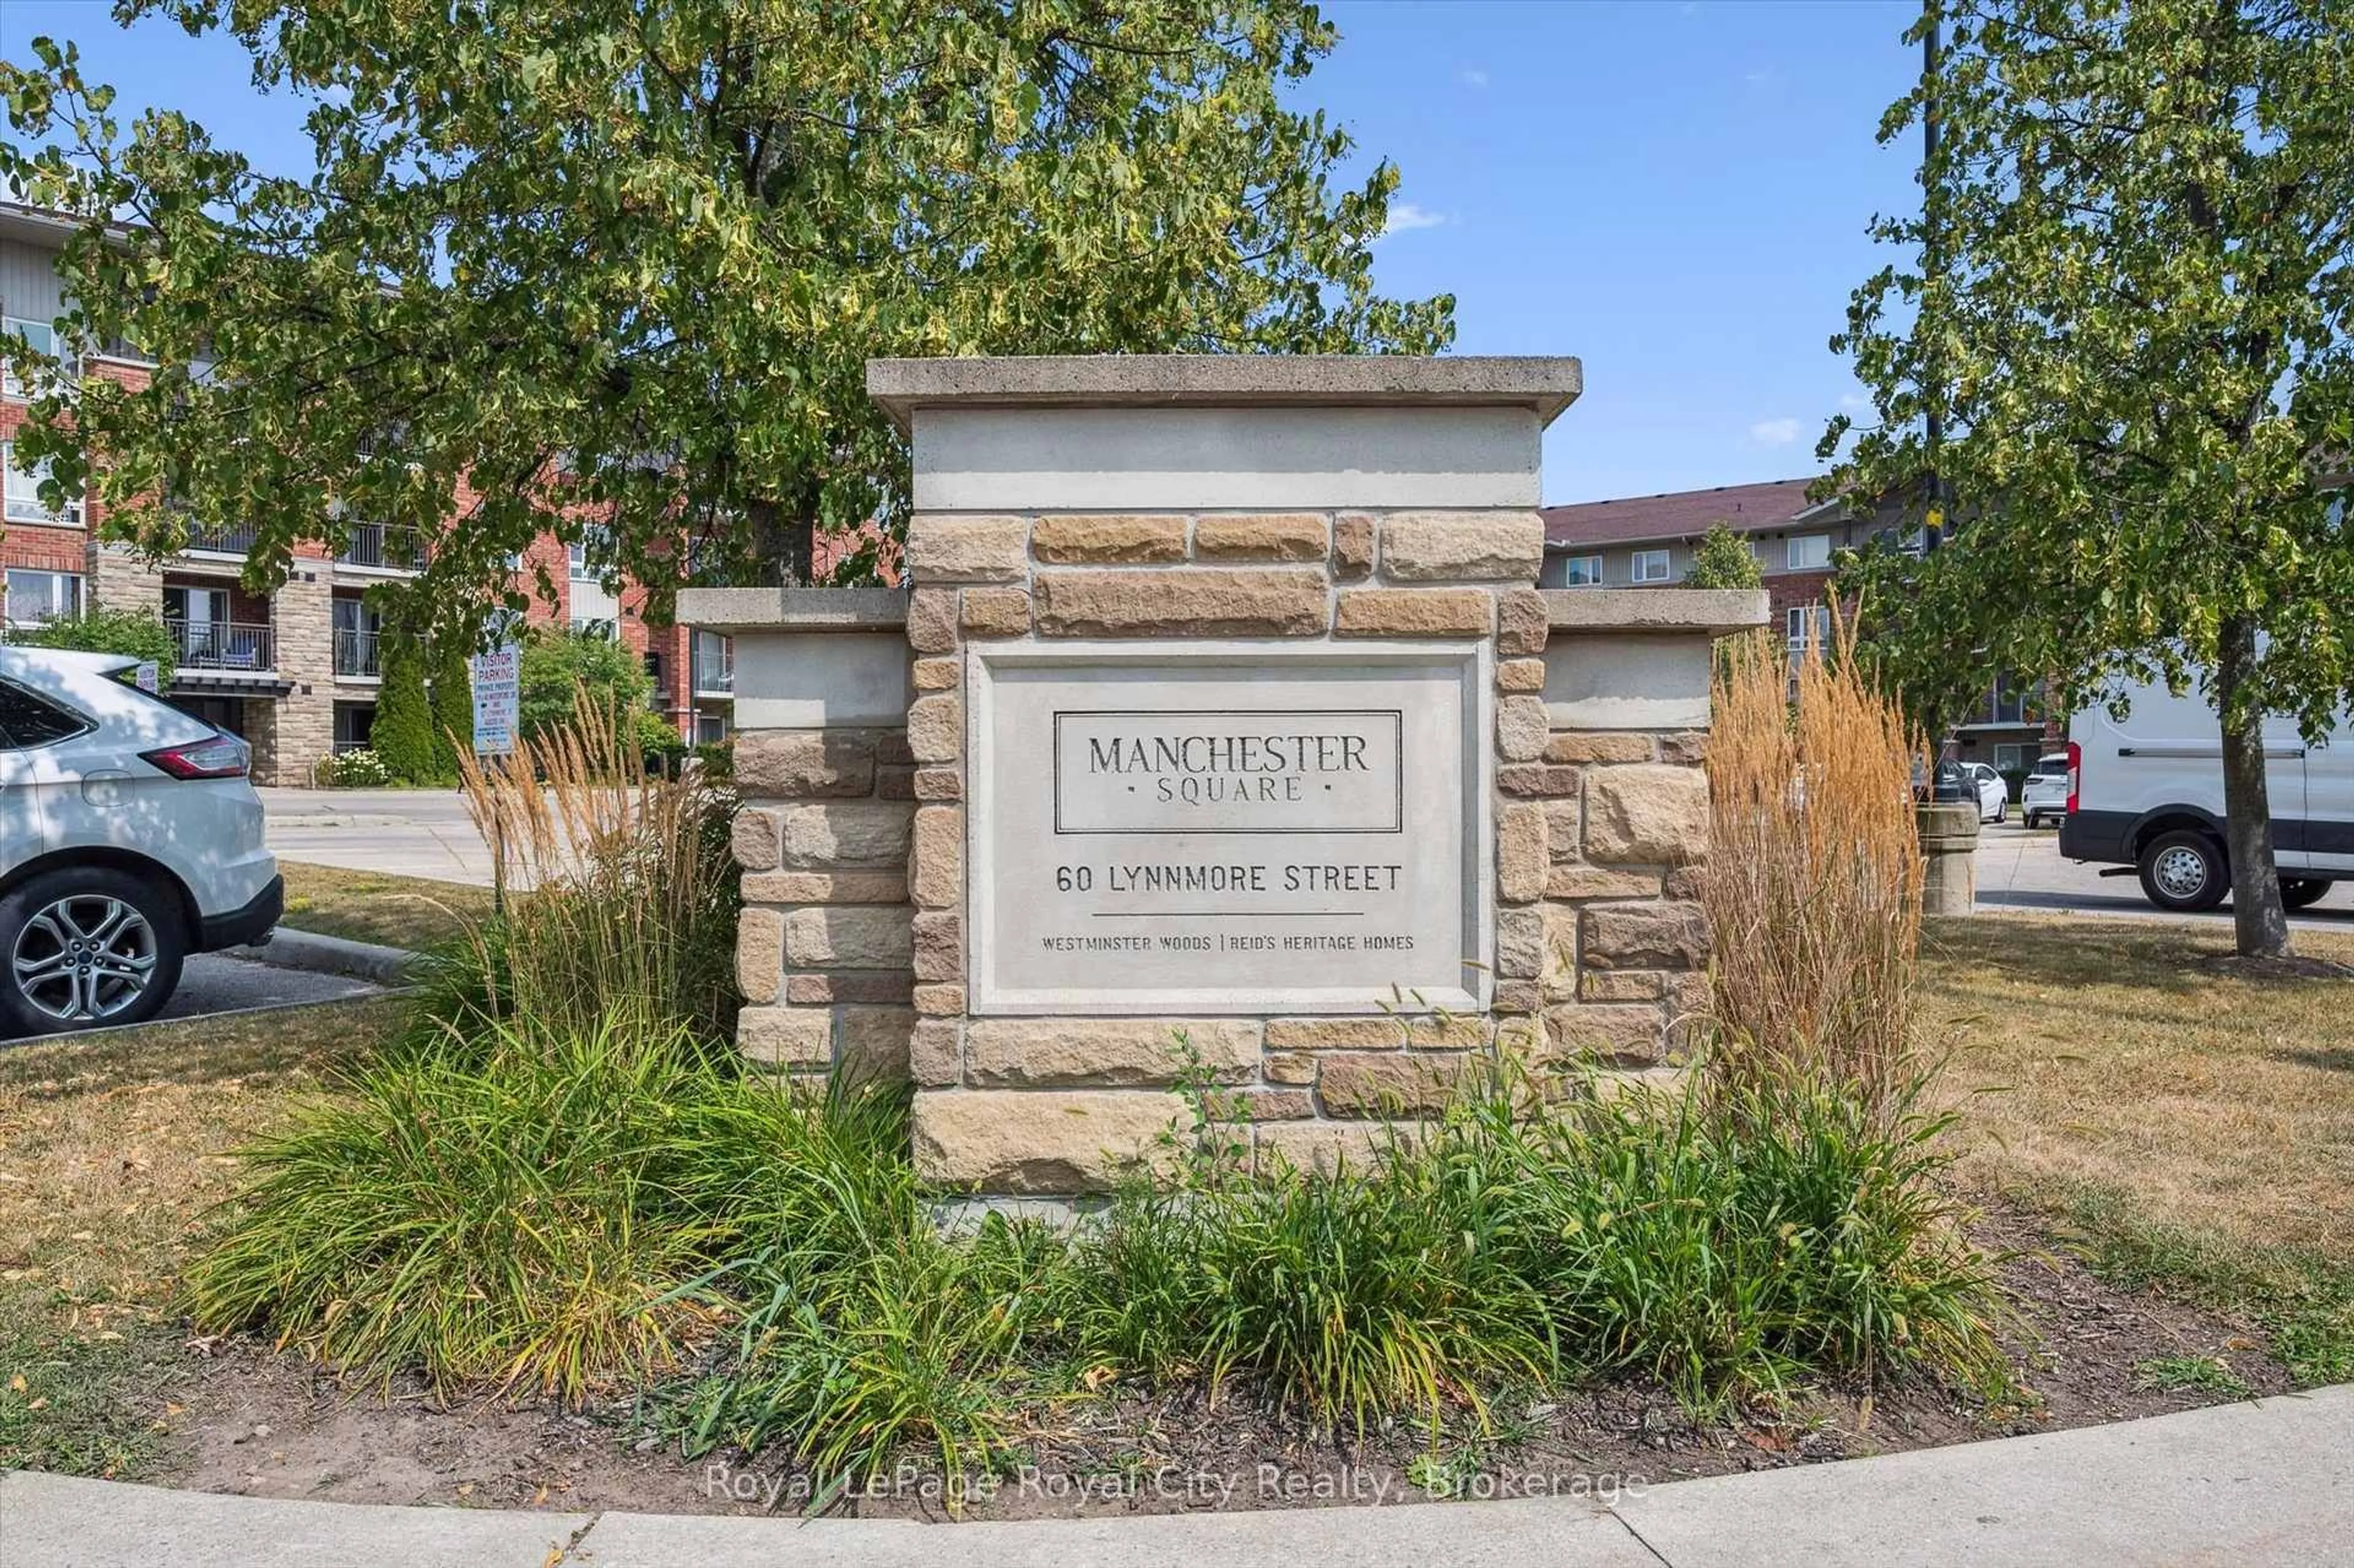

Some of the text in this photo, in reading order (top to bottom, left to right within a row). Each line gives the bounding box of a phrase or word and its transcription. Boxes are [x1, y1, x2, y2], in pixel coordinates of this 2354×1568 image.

[481, 652, 512, 668] VISITOR
[478, 668, 514, 682] PARKING
[1089, 735, 1370, 774] MANCHESTER
[1157, 776, 1301, 806] SQUARE
[1056, 865, 1403, 892] 60 LYNNMORE STREET
[1042, 934, 1414, 951] WESTMINSTER WOODS REID'S HERITAGE HOMES
